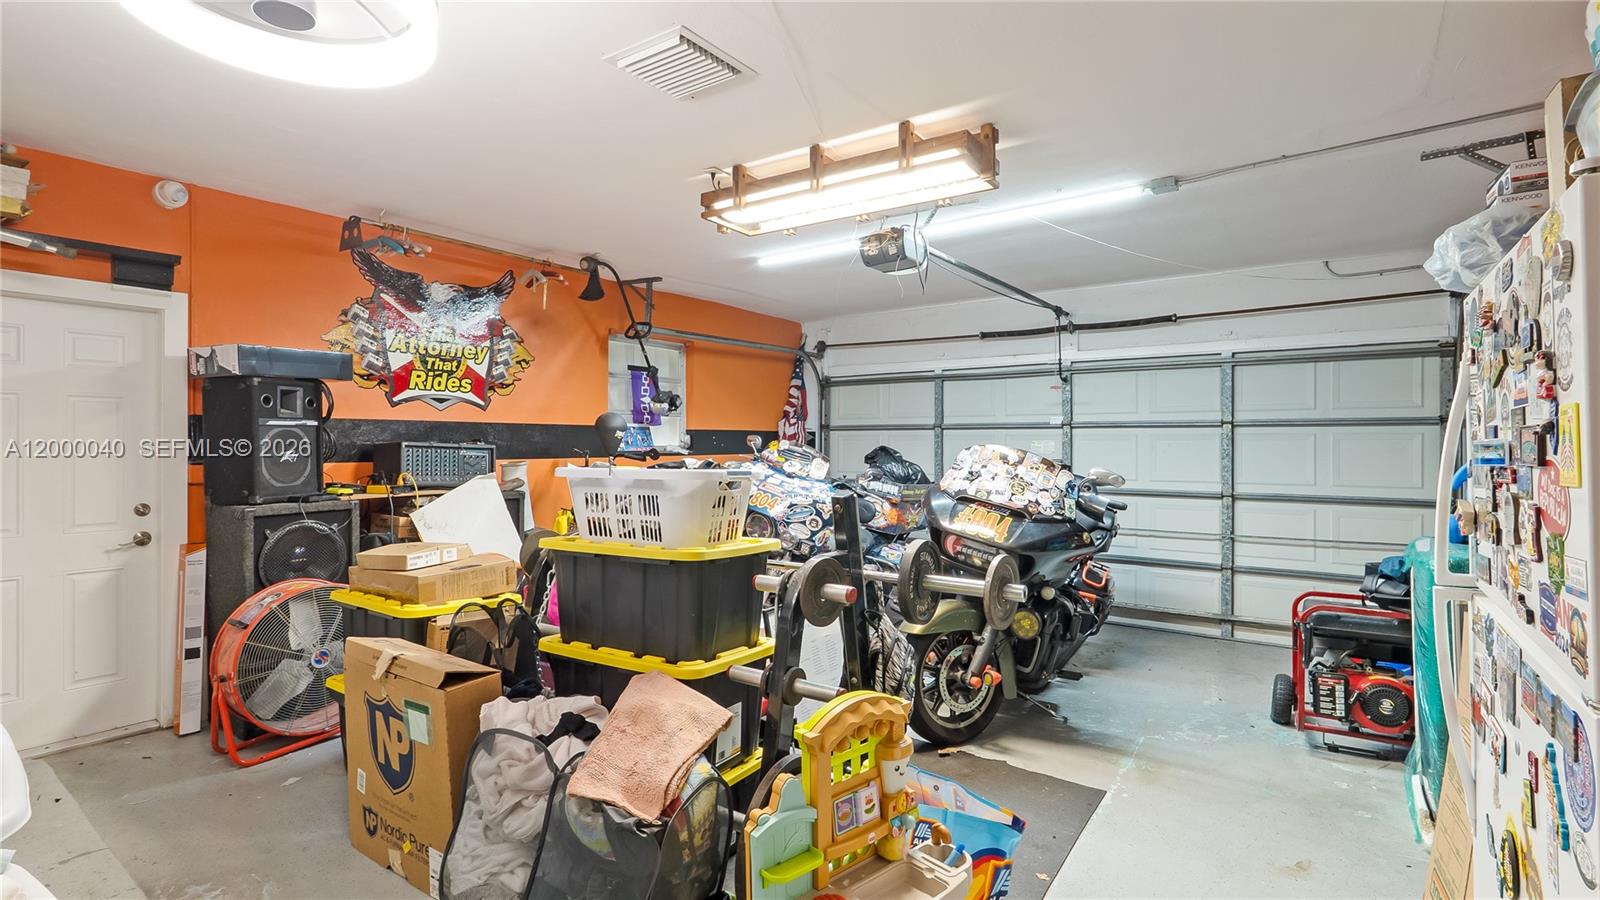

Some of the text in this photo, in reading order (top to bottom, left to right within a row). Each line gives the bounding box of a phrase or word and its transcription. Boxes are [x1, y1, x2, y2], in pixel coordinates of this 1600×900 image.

[1501, 192, 1543, 203] KENWOOD
[388, 330, 489, 364] Attorney
[425, 357, 458, 372] That
[408, 369, 473, 393] Rides
[749, 490, 780, 512] 804
[375, 710, 410, 772] NP
[365, 810, 377, 831] NP
[380, 816, 408, 844] Nordic
